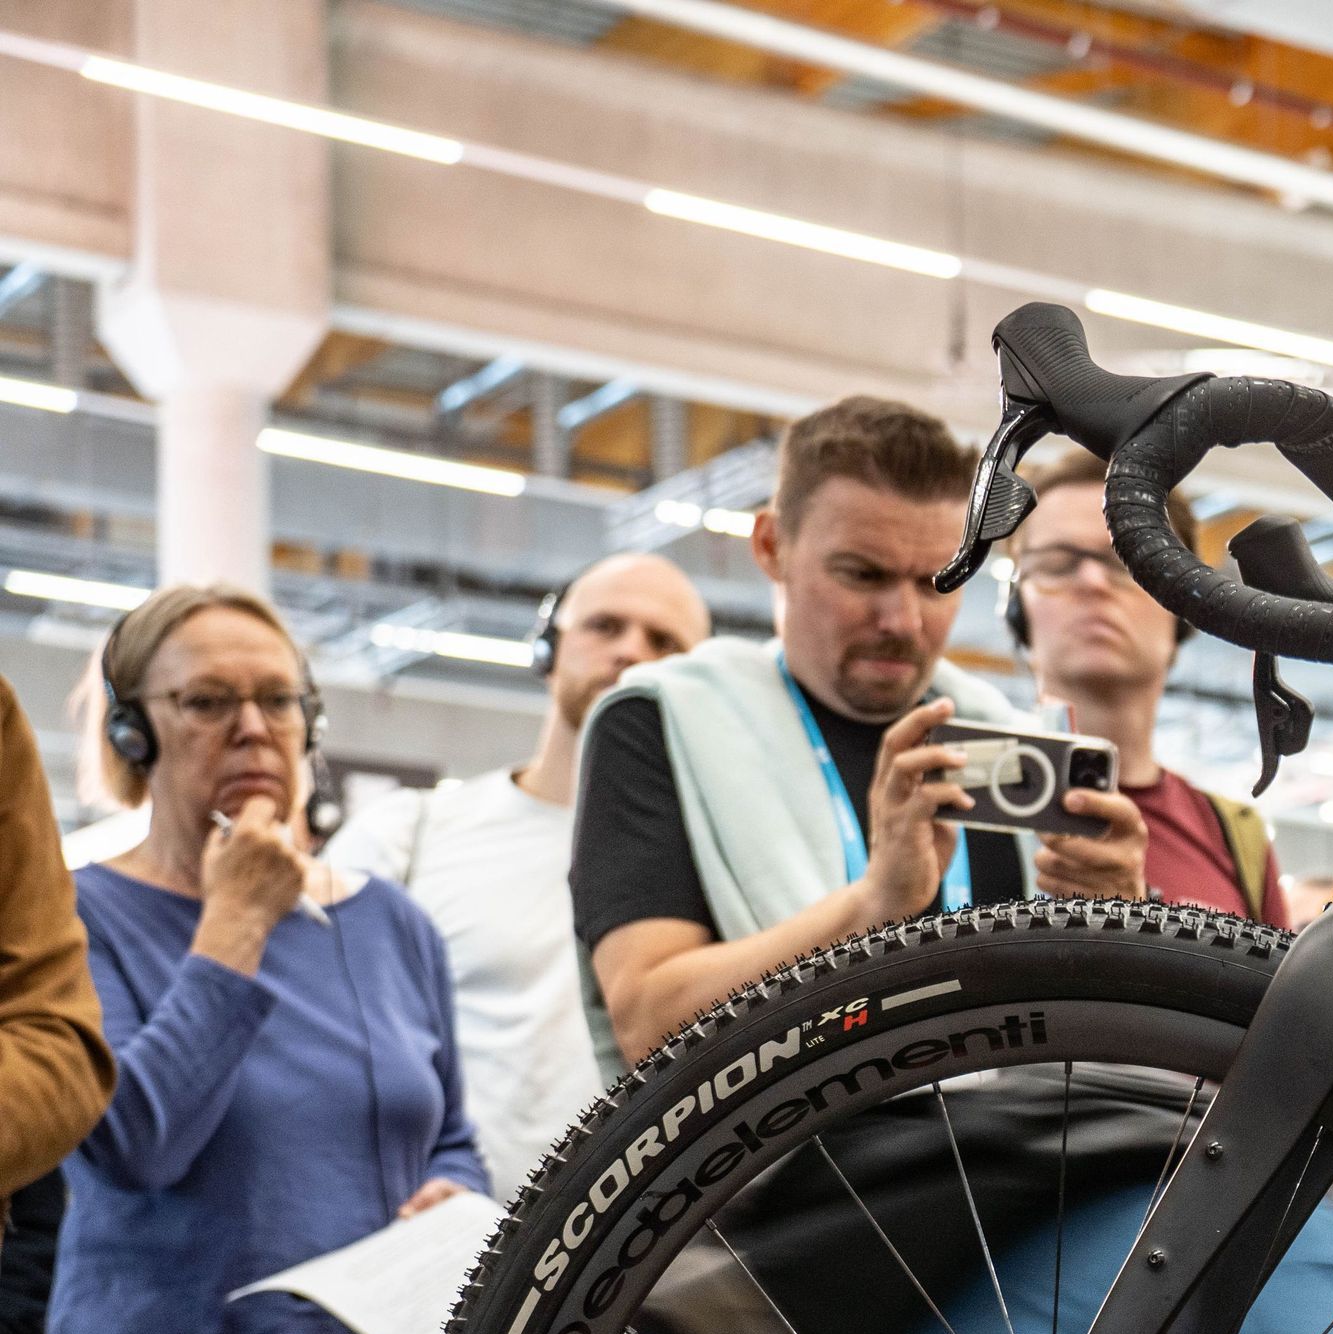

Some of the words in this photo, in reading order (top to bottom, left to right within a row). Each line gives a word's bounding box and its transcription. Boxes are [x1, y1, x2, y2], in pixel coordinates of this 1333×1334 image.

[843, 1009, 868, 1032] H
[805, 1035, 826, 1048] LITE
[534, 1028, 801, 1292] SCORPION
[817, 997, 869, 1027] XC
